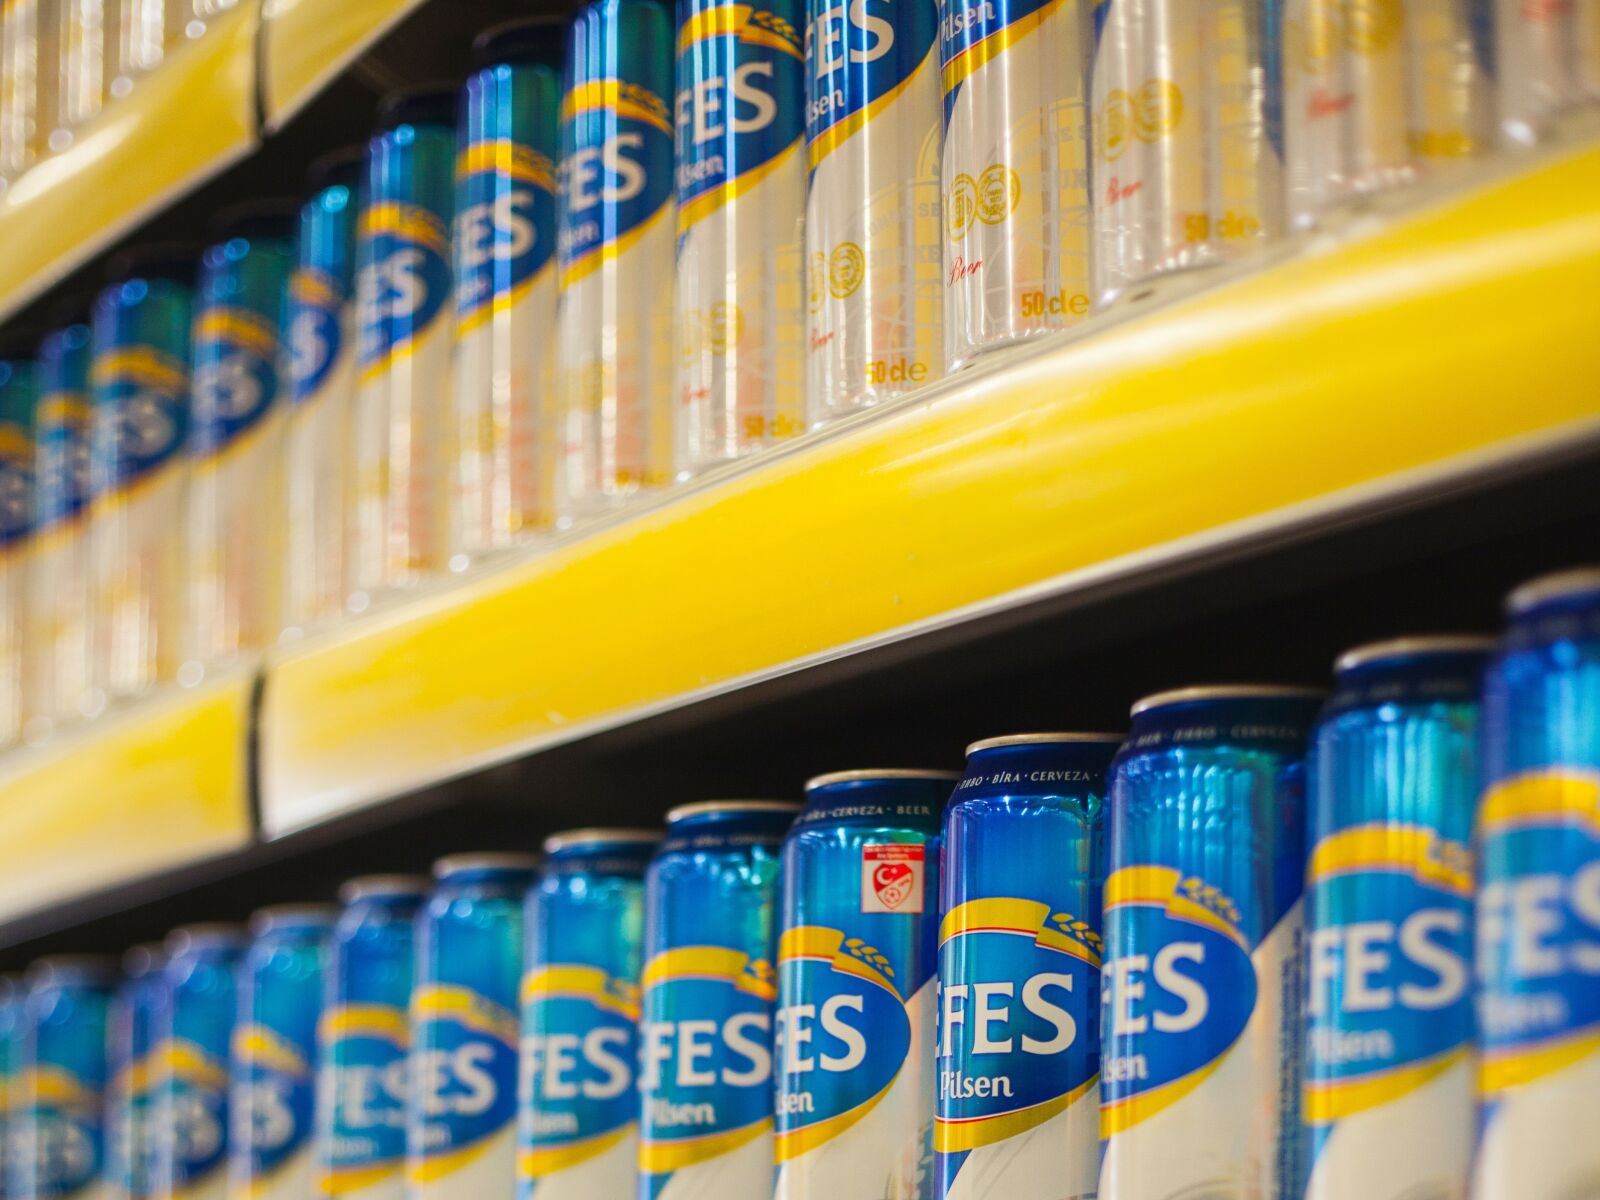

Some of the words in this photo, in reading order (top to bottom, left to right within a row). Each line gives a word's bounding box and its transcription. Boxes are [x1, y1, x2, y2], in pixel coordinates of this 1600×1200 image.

[946, 255, 984, 289] Beer
[1021, 291, 1043, 317] 50
[1030, 771, 1091, 783] CERVEZA
[896, 805, 930, 816] BEER
[1101, 941, 1209, 1036] ES
[1306, 908, 1468, 1016] FES
[935, 972, 1077, 1059] FES
[519, 1026, 632, 1101] FES
[637, 1012, 772, 1093] FES
[940, 1071, 1015, 1101] Pilsen
